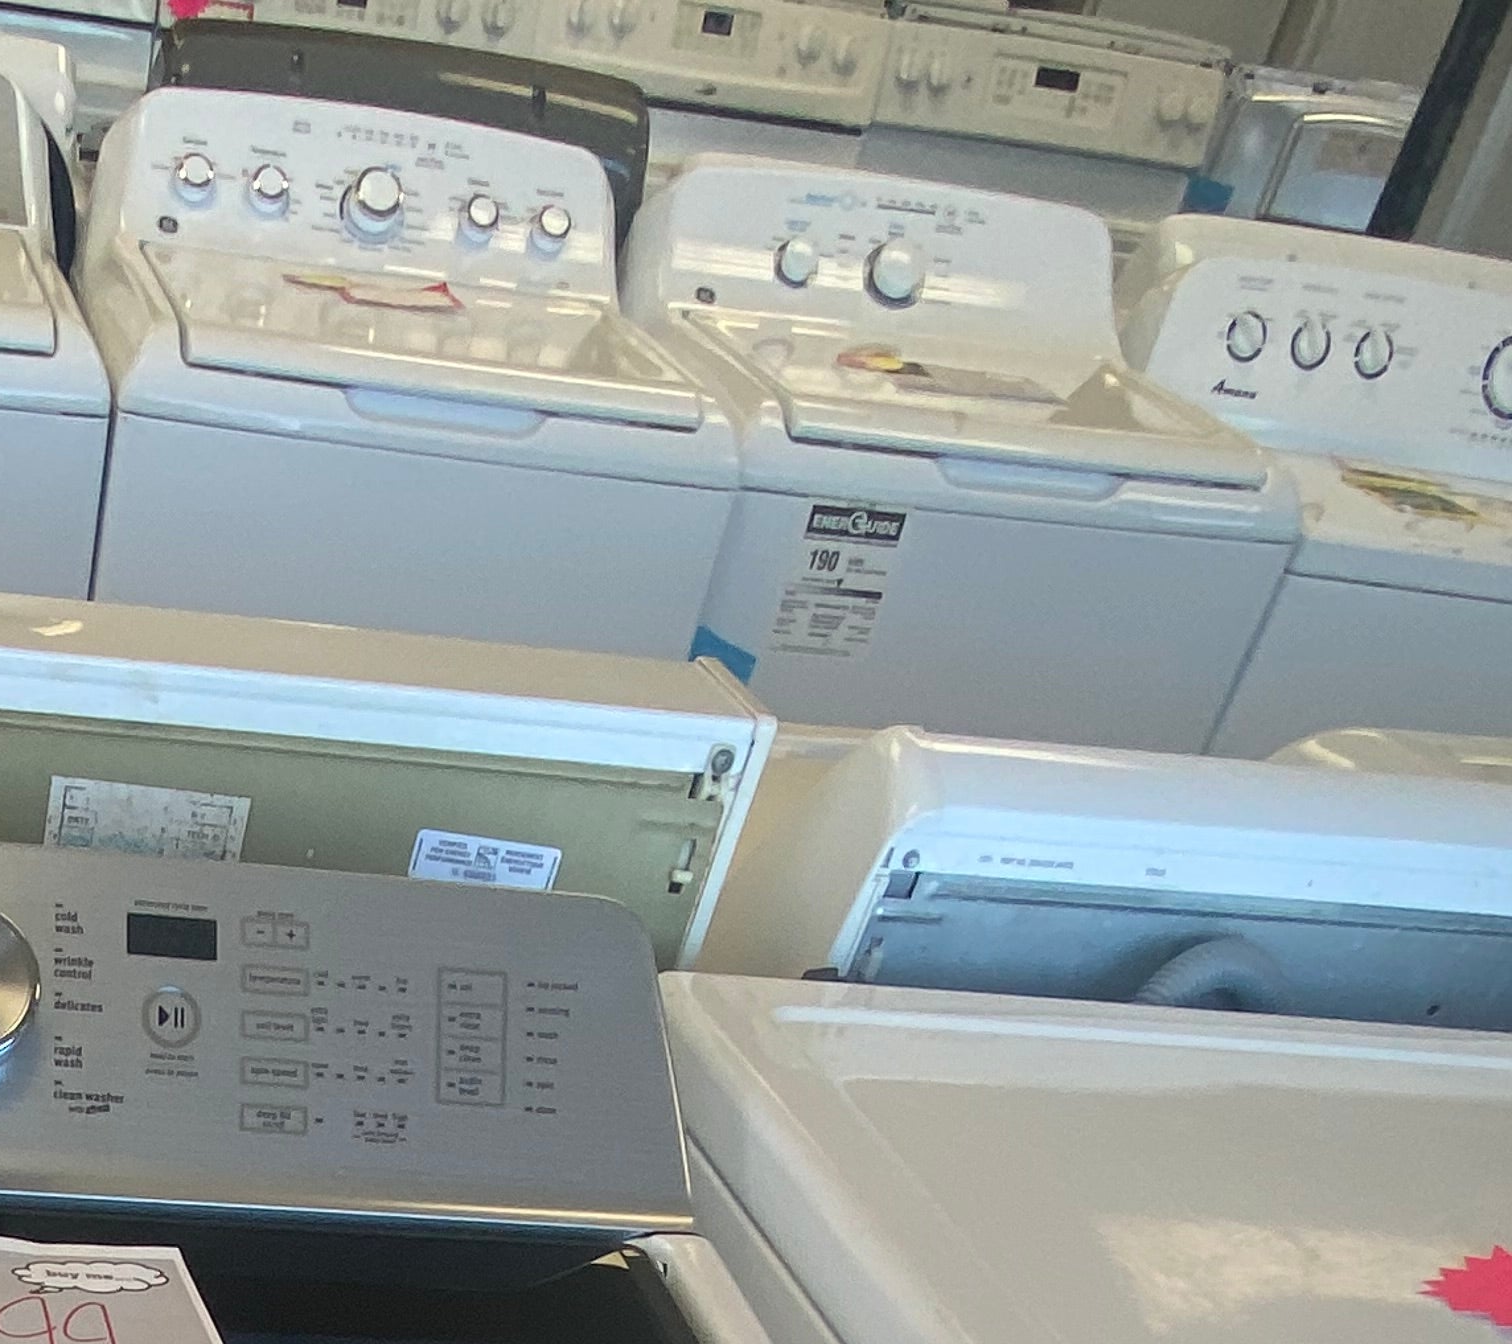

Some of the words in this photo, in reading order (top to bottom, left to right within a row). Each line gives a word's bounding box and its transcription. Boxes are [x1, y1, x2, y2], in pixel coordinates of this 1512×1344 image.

[809, 549, 841, 572] 190
[54, 911, 78, 922] cold
[54, 924, 84, 934] wash
[54, 956, 94, 967] wrinkle
[54, 968, 92, 980] control
[54, 1000, 103, 1012] delicates
[54, 1045, 83, 1057] rapid
[54, 1058, 83, 1069] wash
[53, 1089, 83, 1101] clean
[85, 1092, 125, 1104] washer
[46, 1269, 80, 1280] buy
